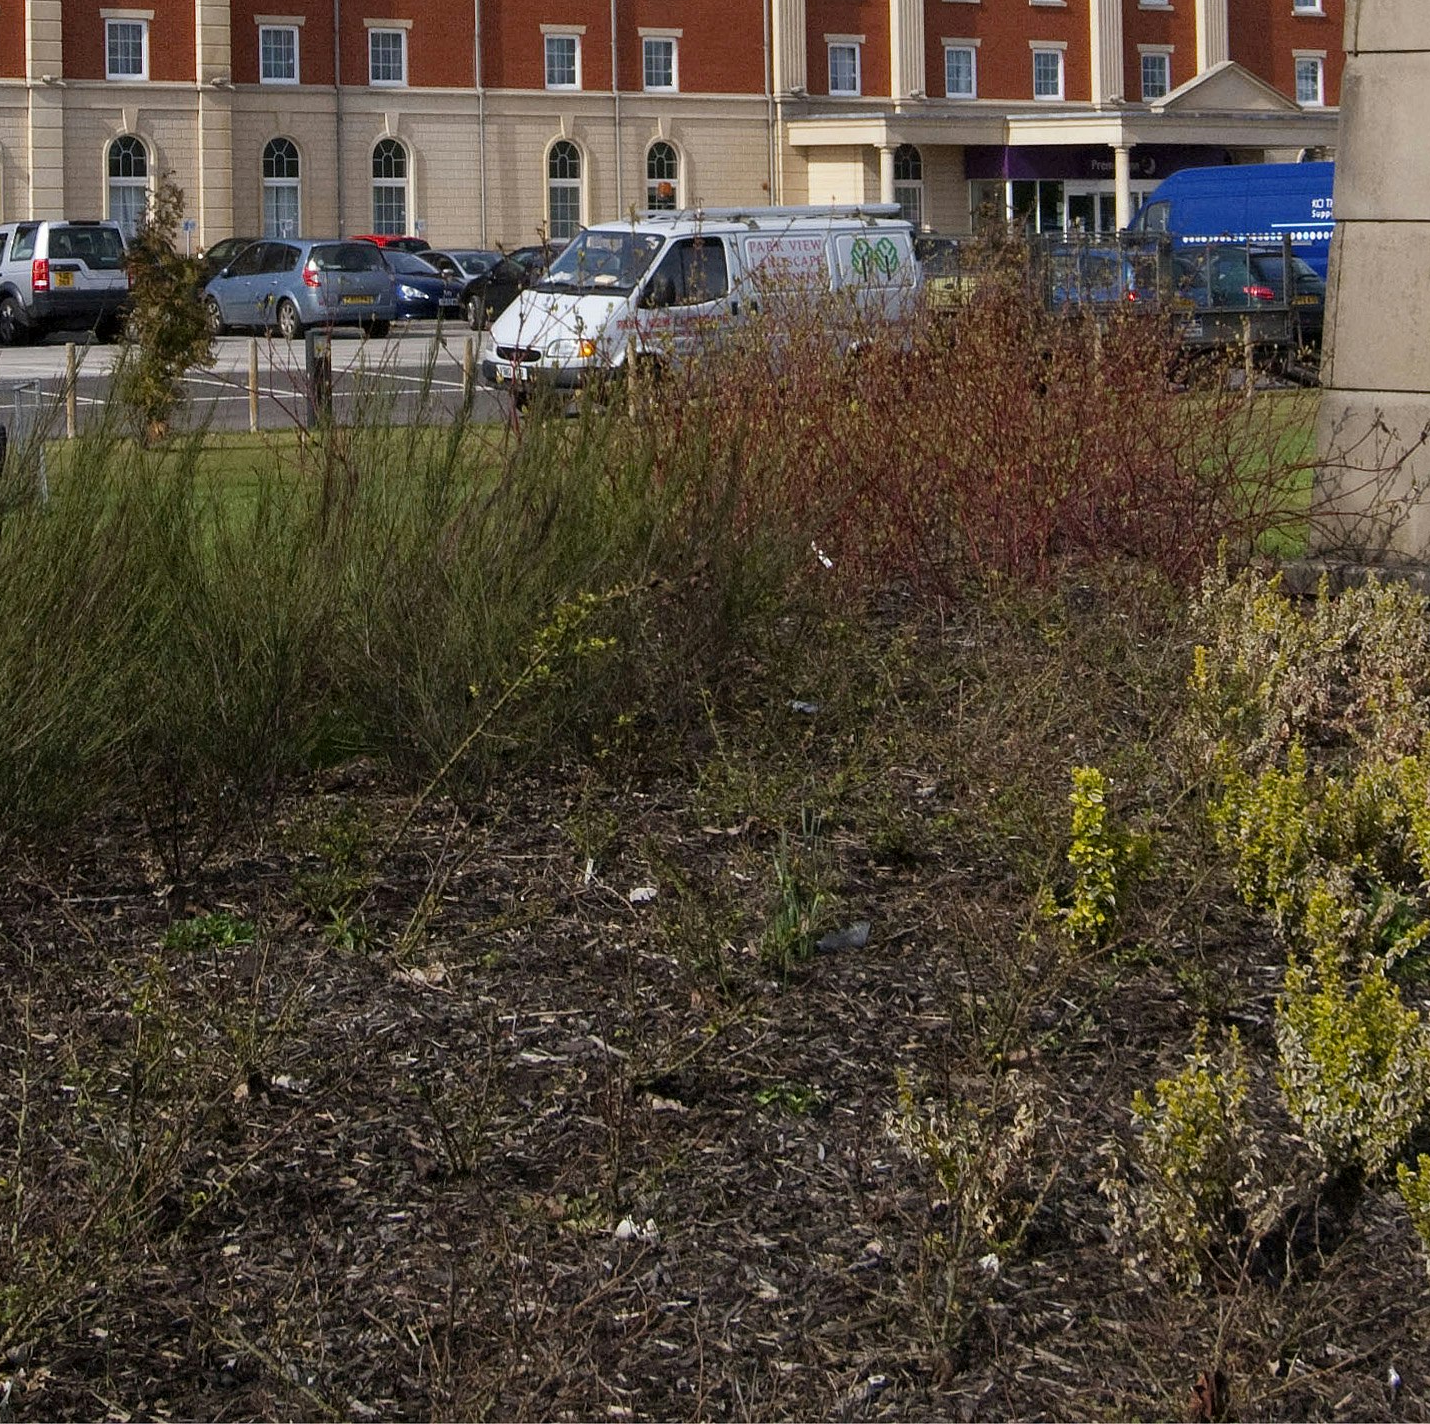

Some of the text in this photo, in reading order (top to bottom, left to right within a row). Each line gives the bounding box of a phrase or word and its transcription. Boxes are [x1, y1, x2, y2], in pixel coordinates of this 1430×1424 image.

[1311, 209, 1333, 220] Supp
[748, 238, 822, 253] PARK VIEW
